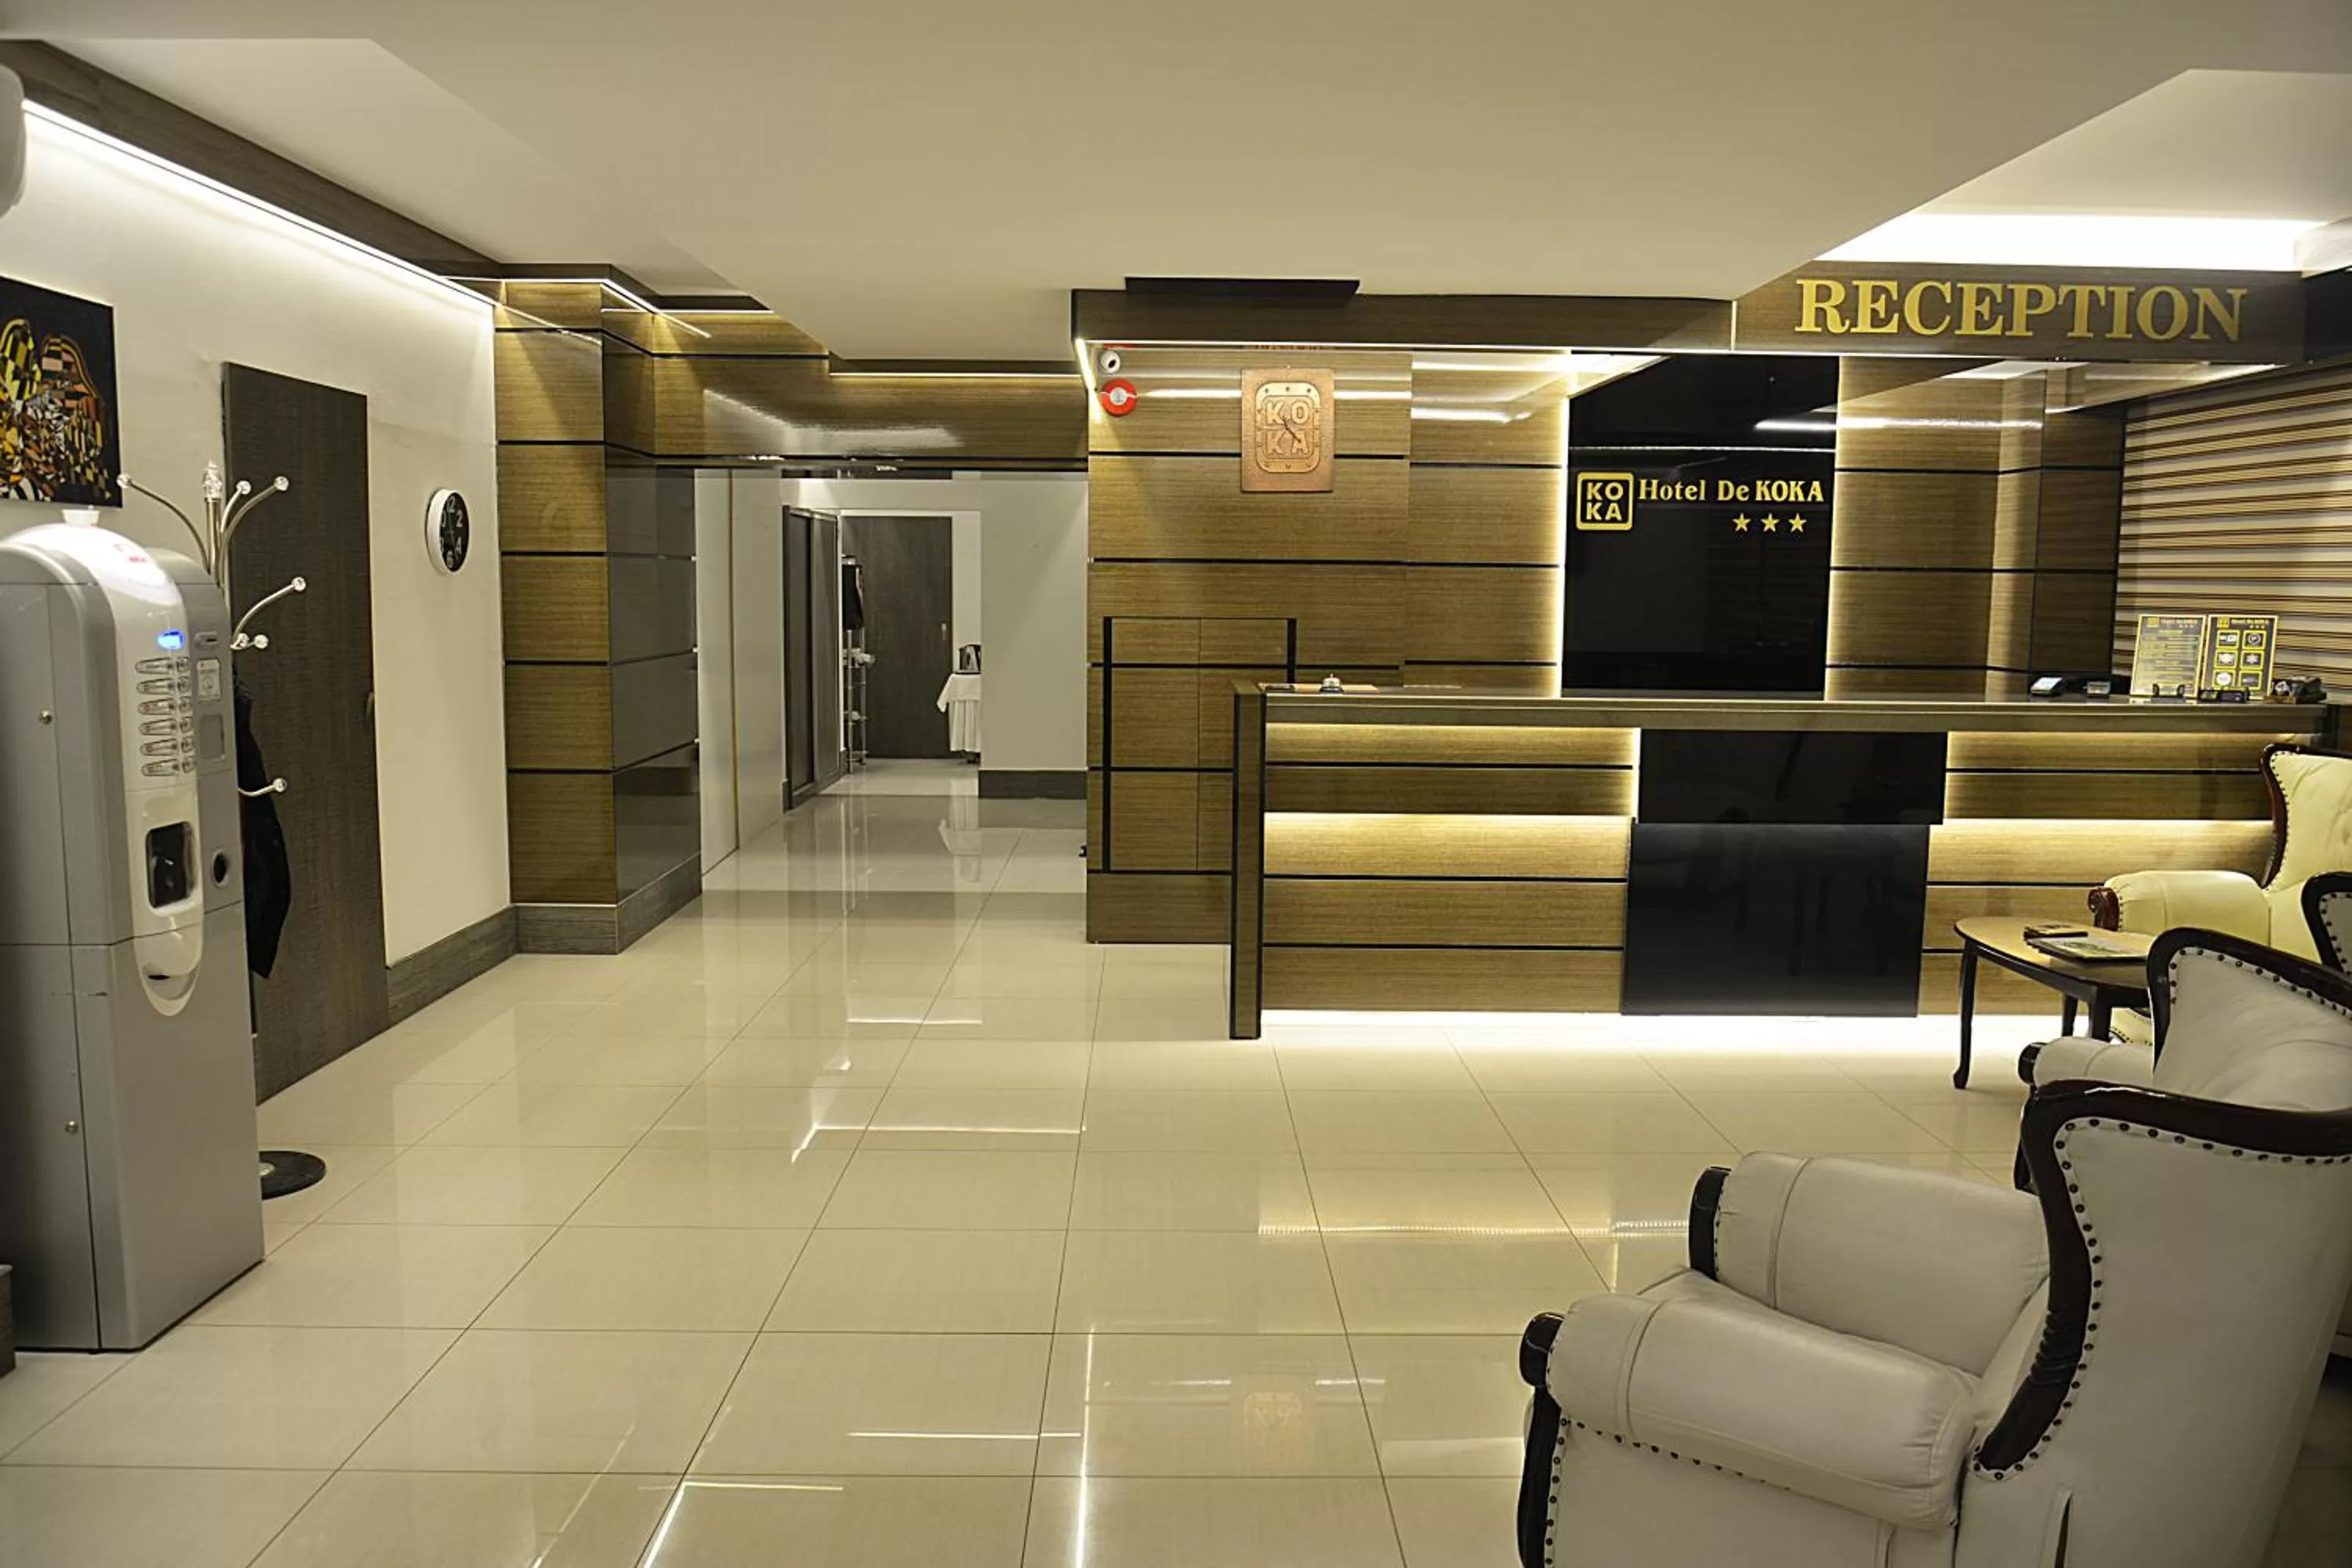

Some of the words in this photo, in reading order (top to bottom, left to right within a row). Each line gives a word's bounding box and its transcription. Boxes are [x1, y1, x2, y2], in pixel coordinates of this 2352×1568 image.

[1795, 278, 2247, 341] RECEPTION
[1266, 401, 1309, 424] KO
[1266, 431, 1308, 454] KA
[1587, 481, 1624, 500] KO
[1639, 479, 1706, 501] Hotel
[1718, 480, 1749, 501] De
[1755, 480, 1824, 502] KOKA
[456, 509, 463, 528] 2
[1586, 502, 1622, 521] KA
